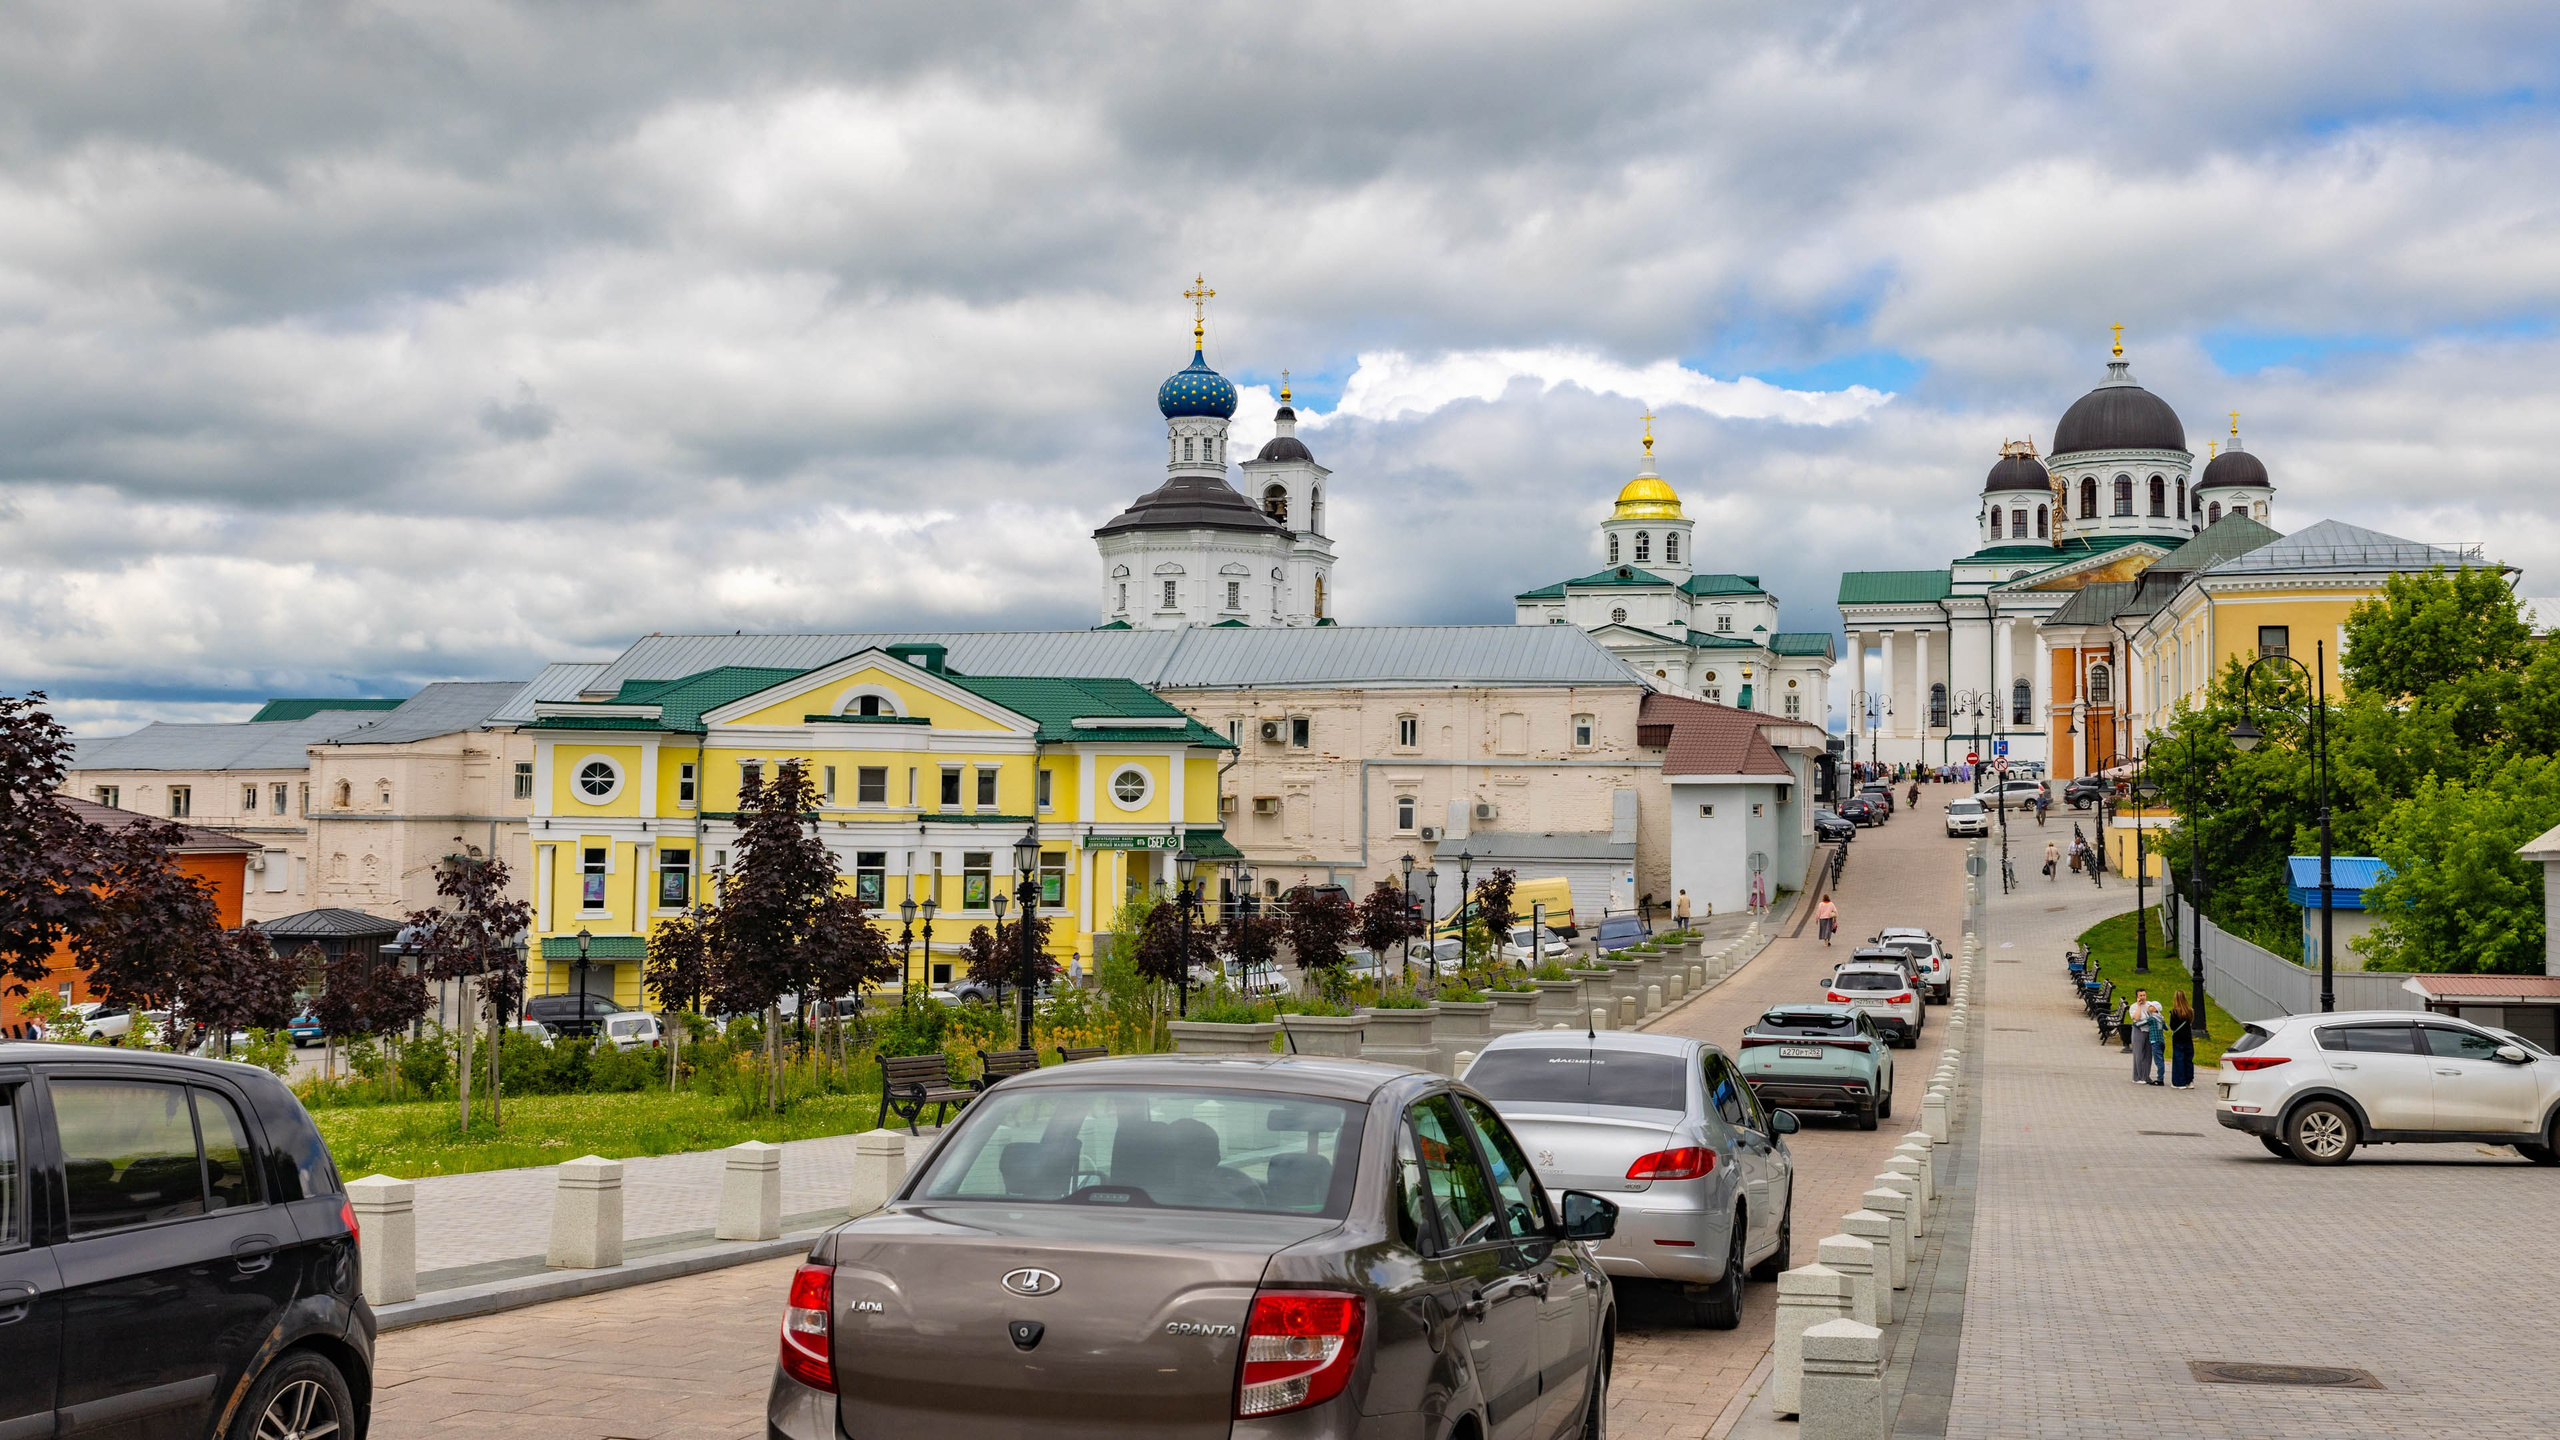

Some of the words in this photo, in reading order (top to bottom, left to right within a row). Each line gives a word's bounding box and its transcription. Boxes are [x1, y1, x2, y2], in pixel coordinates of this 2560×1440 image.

[1148, 836, 1165, 848] СБЕР
[851, 1300, 884, 1314] LADA
[1165, 1321, 1237, 1338] GRANTA
